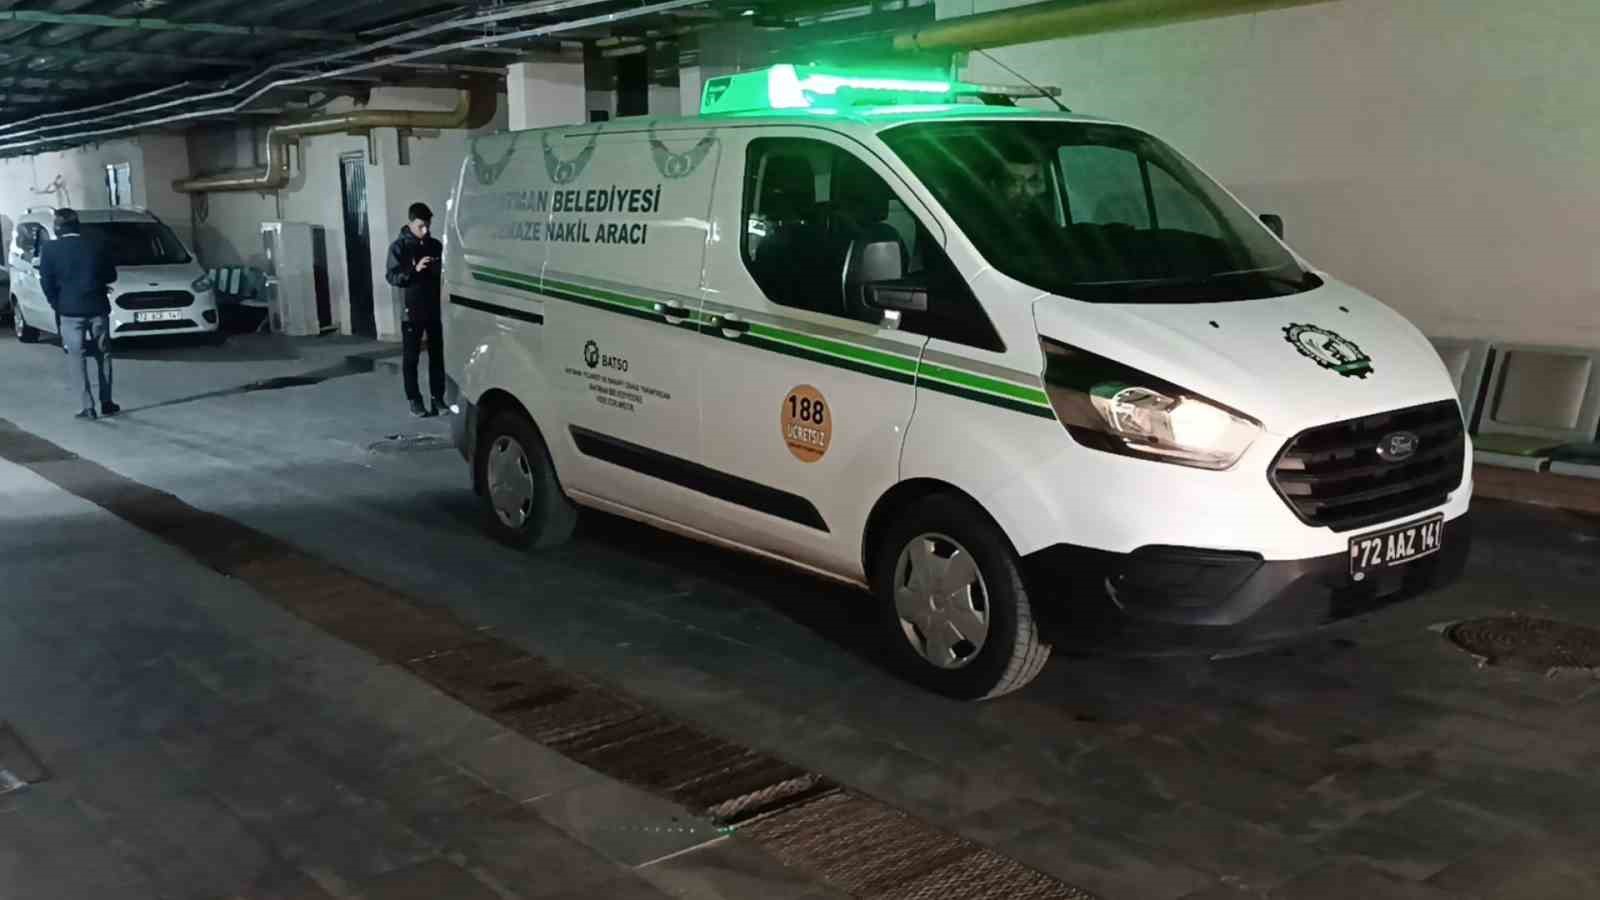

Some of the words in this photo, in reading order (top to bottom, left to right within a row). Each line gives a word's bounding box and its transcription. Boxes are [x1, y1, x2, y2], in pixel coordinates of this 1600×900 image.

[552, 184, 662, 213] BELEDİYESİ
[546, 218, 591, 243] NAKİL
[594, 223, 648, 245] ARACI
[601, 354, 629, 373] BATSO
[788, 394, 824, 425] 188
[1360, 537, 1382, 568] 72
[1385, 528, 1416, 561] AAZ
[1420, 520, 1441, 551] 141
